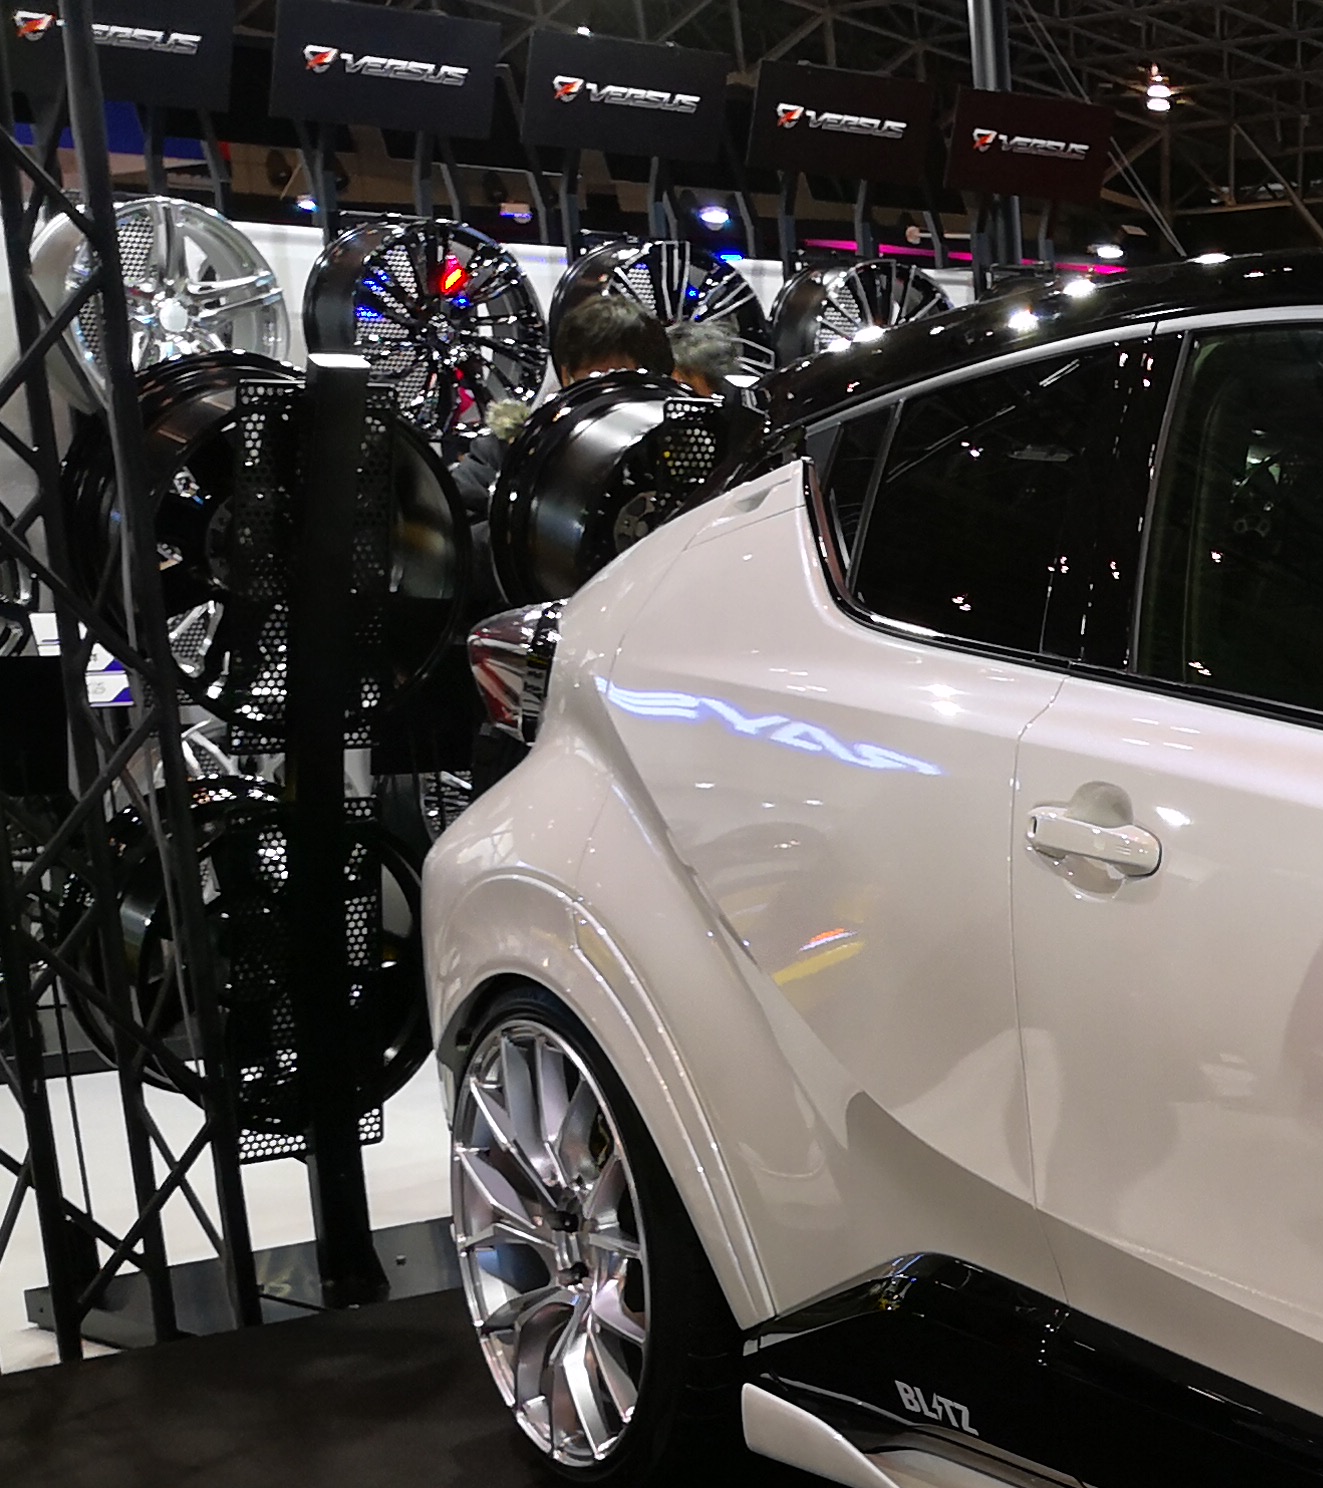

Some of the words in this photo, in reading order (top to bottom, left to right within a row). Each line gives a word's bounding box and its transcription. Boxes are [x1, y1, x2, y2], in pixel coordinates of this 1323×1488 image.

[56, 18, 202, 55] ERSUS
[341, 51, 471, 87] VERSUS
[586, 82, 701, 115] VERSUS
[806, 109, 908, 139] VERSUS
[999, 134, 1090, 160] VERSUS
[894, 1379, 979, 1436] BLITZ
